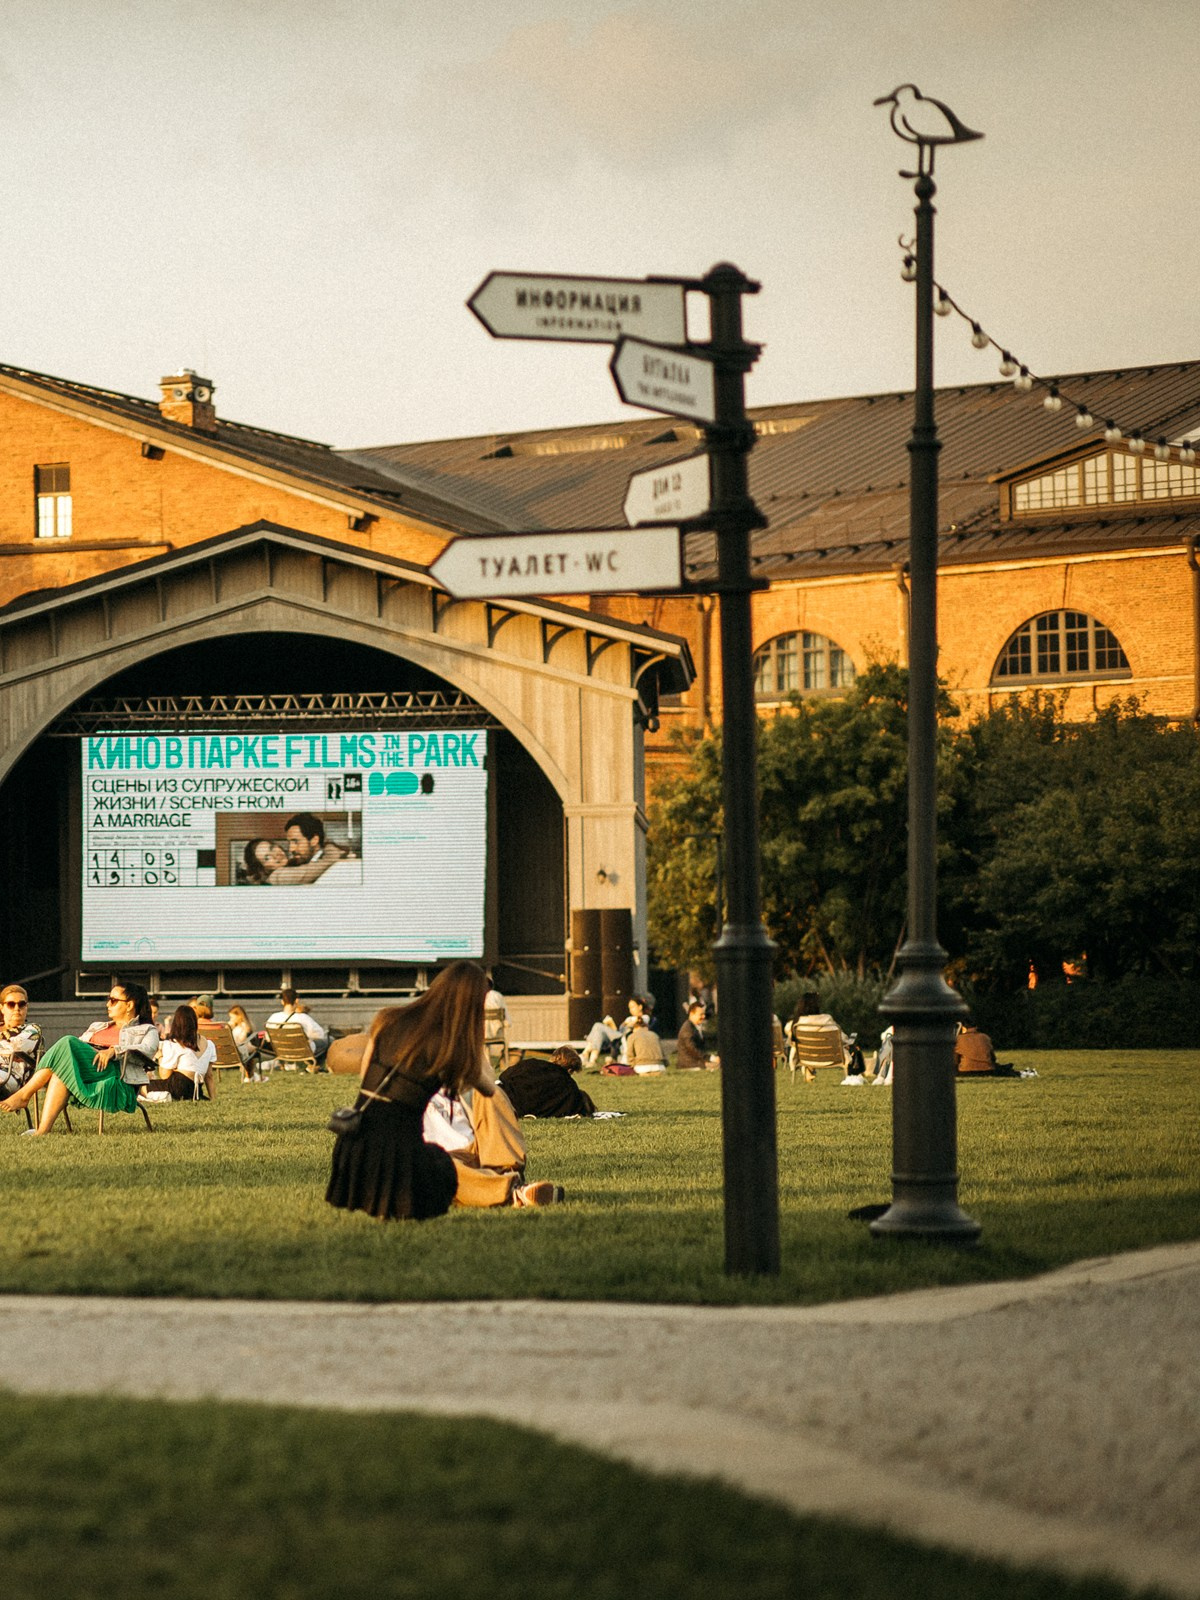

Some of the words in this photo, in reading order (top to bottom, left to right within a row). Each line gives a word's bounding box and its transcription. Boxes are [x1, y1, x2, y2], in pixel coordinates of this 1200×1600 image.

[516, 288, 641, 315] ИНФОРМАЦИЯ
[479, 553, 567, 577] ТУАЛЕТ
[585, 550, 618, 572] WC
[88, 736, 160, 769] КИНО
[165, 737, 183, 768] В
[188, 736, 280, 768] ПАРКЕ
[285, 735, 376, 768] FILMS
[383, 734, 400, 750] IN
[408, 733, 479, 767] PARK
[379, 751, 404, 767] THE
[92, 779, 150, 794] СЦЕНЫ
[156, 779, 178, 792] ИЗ
[182, 775, 309, 792] СУПРУЖЕСКОЙ
[93, 796, 156, 810] ЖИЗНИ
[170, 796, 233, 809] SCENES
[238, 796, 284, 809] FROM
[93, 814, 104, 827] A
[108, 813, 191, 827] MARRIAGE
